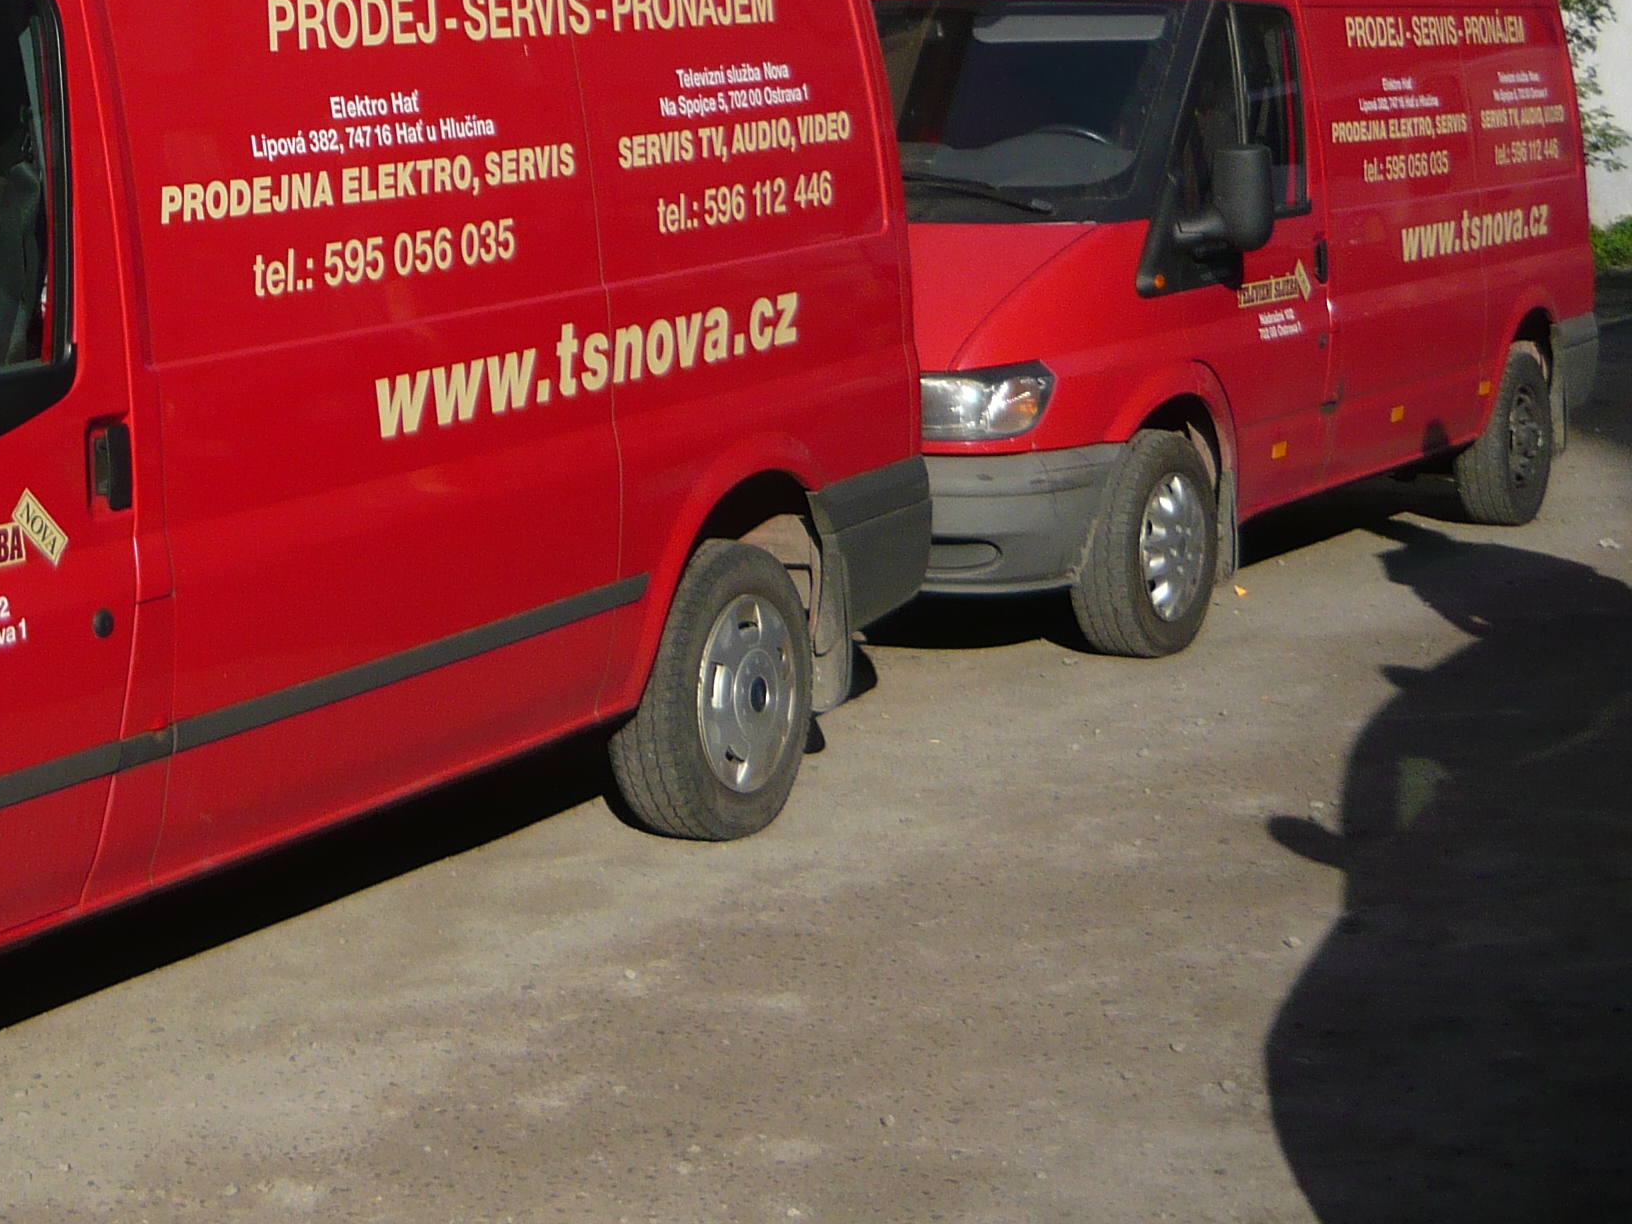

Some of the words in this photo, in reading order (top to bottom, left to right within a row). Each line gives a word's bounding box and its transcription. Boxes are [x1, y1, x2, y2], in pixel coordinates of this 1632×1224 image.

[726, 62, 761, 84] služba
[763, 61, 789, 80] Nova
[330, 94, 387, 119] Elektro
[390, 88, 419, 114] Hať
[659, 97, 676, 117] Na
[678, 93, 716, 118] Spojce
[717, 92, 729, 114] 5,
[728, 89, 749, 110] 702
[749, 87, 762, 107] 00
[764, 85, 802, 105] Ostrava
[251, 130, 306, 161] Lipová
[309, 128, 345, 155] 382,
[345, 125, 372, 149] 747
[374, 123, 392, 147] 16
[426, 125, 436, 143] u
[440, 114, 495, 139] Hlučína
[618, 129, 693, 168] SERVIS
[698, 126, 728, 162] TV,
[731, 117, 796, 152] AUDIO,
[797, 110, 850, 144] VIDEO
[1332, 119, 1387, 143] PRODEJNA
[1388, 115, 1435, 139] ELEKTRO,
[1435, 112, 1467, 135] SERVIS
[160, 171, 333, 224] PRODEJNA
[342, 154, 481, 204] ELEKTRO,
[485, 142, 575, 185] SERVIS
[1386, 154, 1406, 180] 595
[1408, 152, 1428, 177] 056
[1429, 150, 1449, 175] 035
[657, 193, 698, 233] tel.:
[704, 183, 745, 226] 596
[752, 176, 786, 216] 112
[794, 170, 832, 209] 446
[253, 248, 313, 297] tel.:
[324, 236, 384, 287] 595
[394, 227, 452, 276] 056
[461, 218, 515, 265] 035
[1401, 204, 1549, 263] www.tsnova.cz
[375, 291, 799, 439] www.tsnova.cz
[20, 501, 56, 555] NOVA
[19, 618, 27, 639] 1
